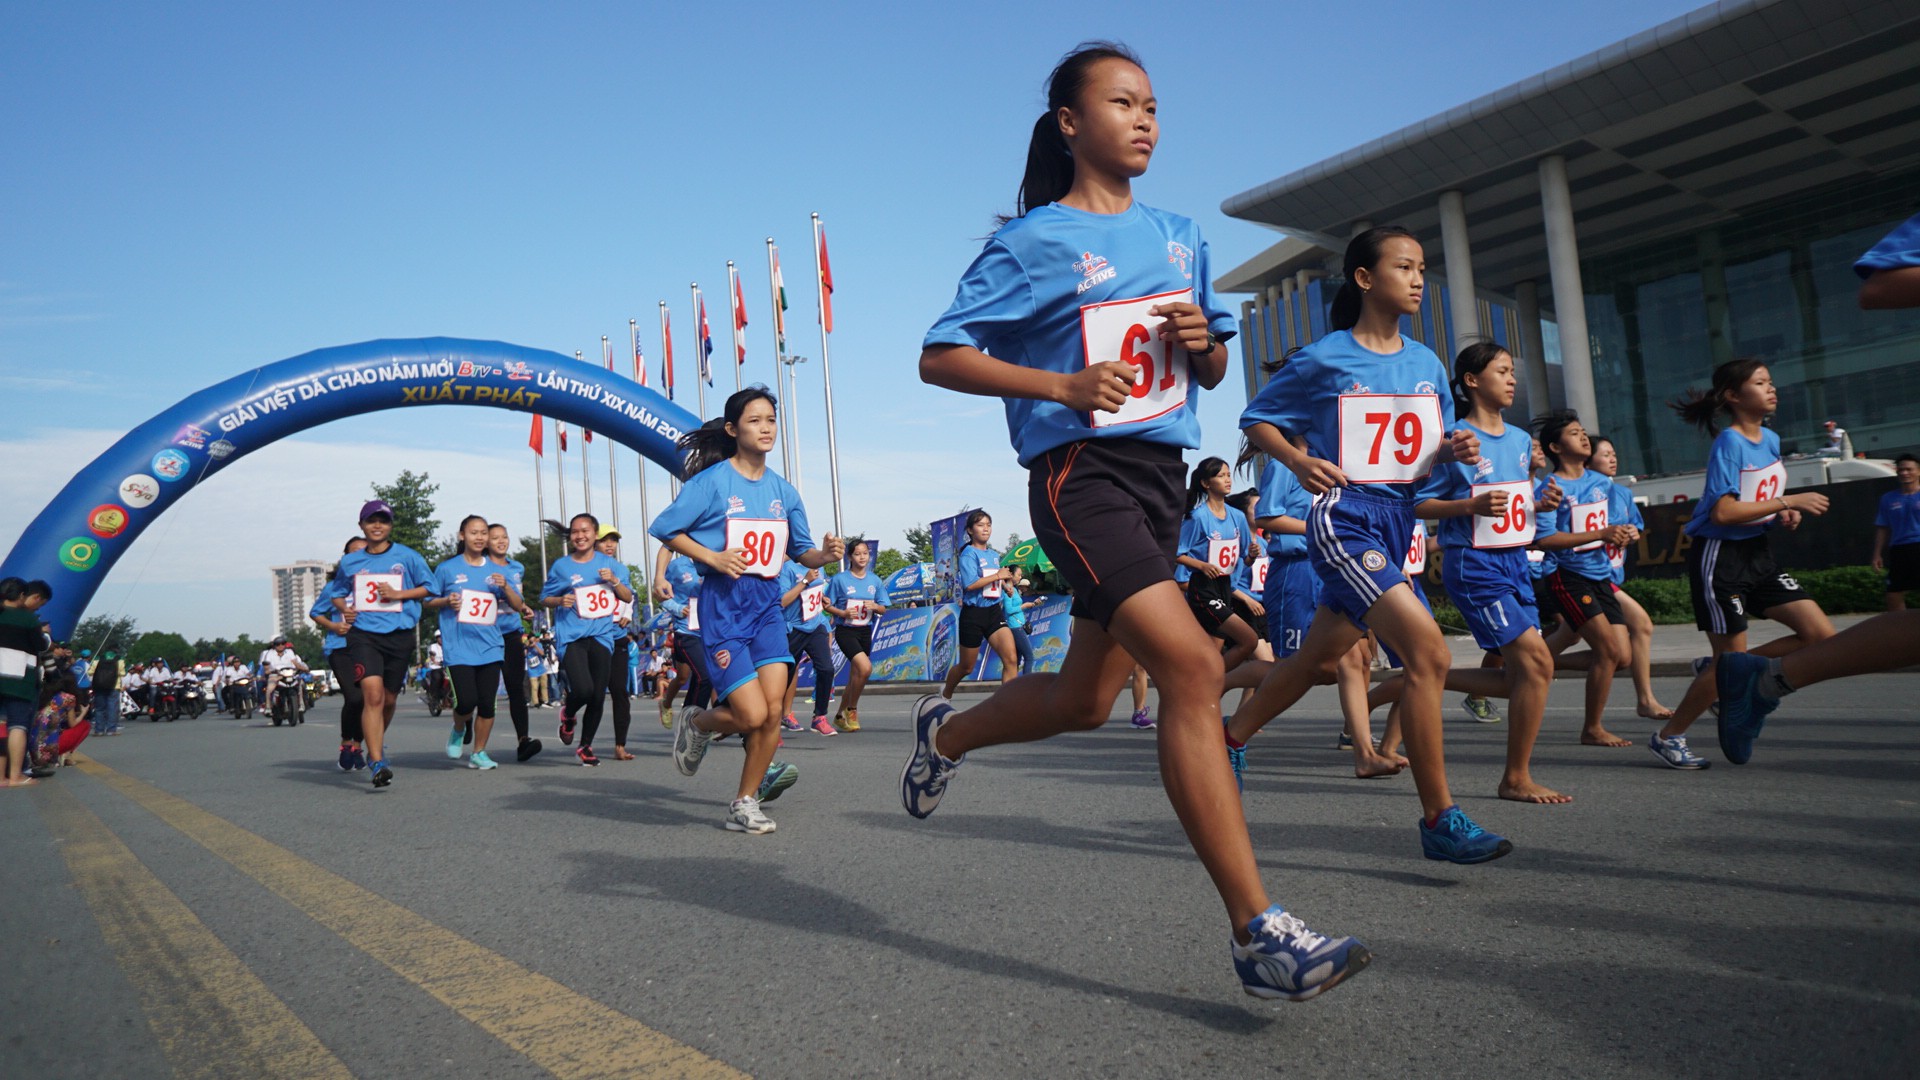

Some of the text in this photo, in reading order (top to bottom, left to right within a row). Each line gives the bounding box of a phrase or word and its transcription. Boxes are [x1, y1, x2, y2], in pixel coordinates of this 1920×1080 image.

[1077, 266, 1117, 294] ACTIVE
[1119, 323, 1177, 398] 61
[219, 404, 259, 432] GIẢI
[254, 388, 297, 415] VIỆT
[298, 378, 329, 400] DÃ
[326, 366, 378, 391] CHÀO
[421, 358, 454, 378] MỚI
[458, 361, 492, 378] BTV
[537, 369, 568, 391] LẦN
[569, 379, 602, 400] THỨ
[600, 391, 626, 412] XIX
[624, 402, 659, 430] NĂM
[402, 378, 542, 407] XUẤT PHÁT
[1365, 411, 1423, 466] 79
[123, 483, 154, 501] Soya
[741, 530, 775, 567] 80
[1218, 545, 1238, 568] 65
[468, 597, 493, 618] 37
[586, 589, 610, 612] 36
[808, 590, 822, 612] 34
[1483, 600, 1509, 630] 17
[1285, 628, 1302, 650] 21
